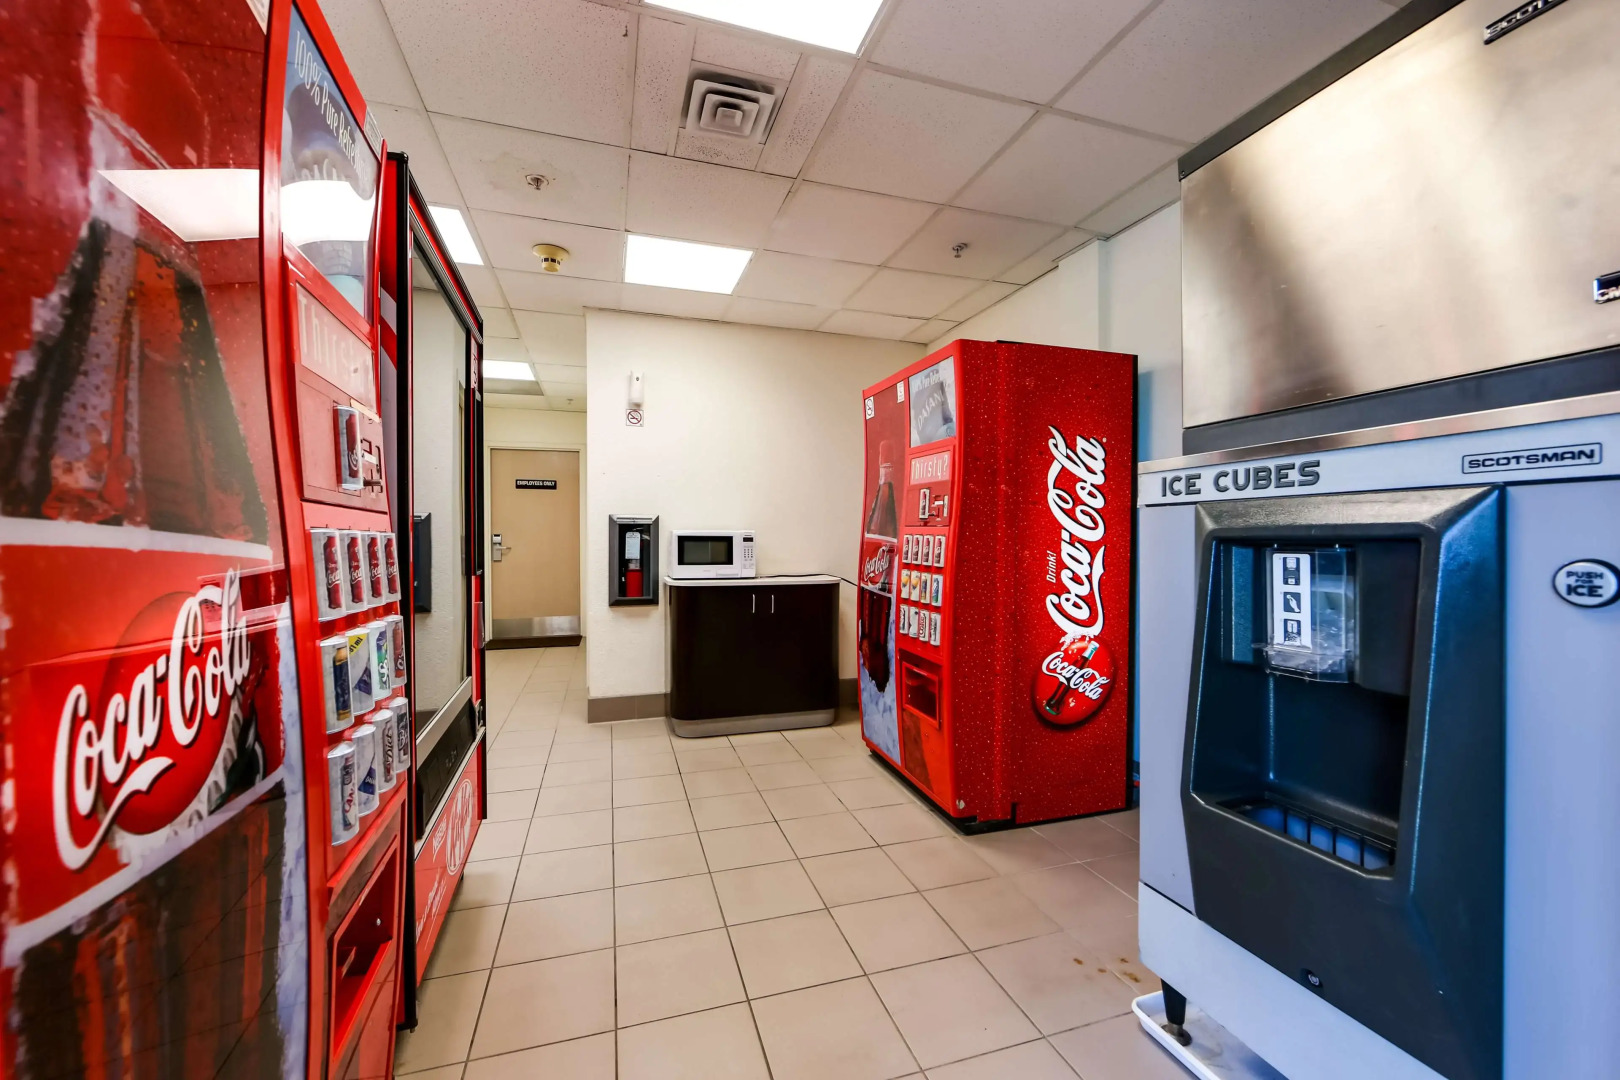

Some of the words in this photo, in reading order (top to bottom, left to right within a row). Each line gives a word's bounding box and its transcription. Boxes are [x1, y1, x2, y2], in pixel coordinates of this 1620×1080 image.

[294, 30, 321, 105] 100%
[321, 81, 338, 136] Pure
[911, 454, 948, 480] Thirsty?
[1468, 449, 1595, 469] SCOTSMAN
[1162, 473, 1202, 497] ICE
[1213, 460, 1320, 493] CUBES
[1046, 550, 1057, 583] Drink!
[1566, 570, 1604, 580] PUSH
[1566, 584, 1604, 598] ICE
